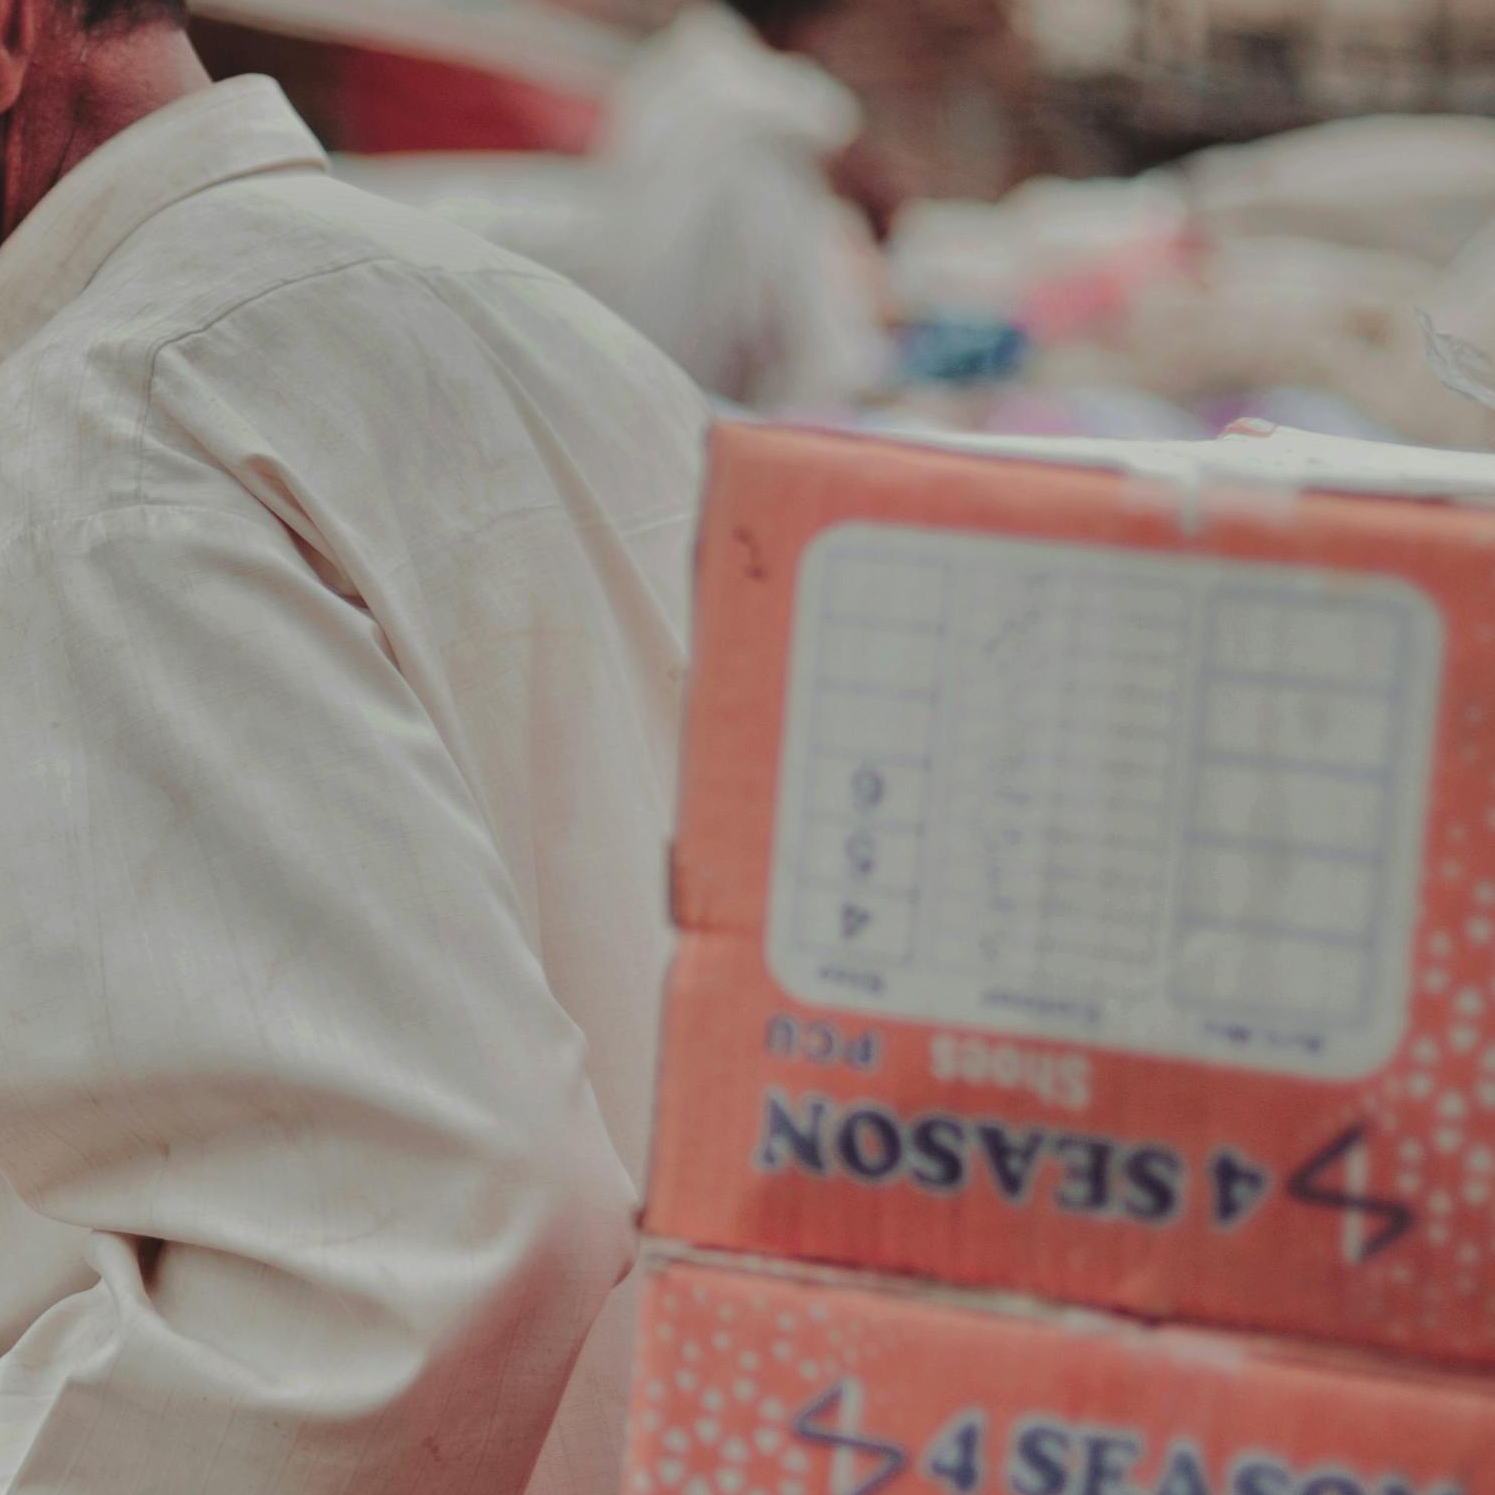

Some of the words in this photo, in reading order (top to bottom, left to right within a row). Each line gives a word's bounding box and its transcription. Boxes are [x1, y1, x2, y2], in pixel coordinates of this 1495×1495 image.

[929, 1034, 1092, 1113] Shoes
[761, 1092, 1184, 1222] SEASON
[1210, 1147, 1268, 1226] 4
